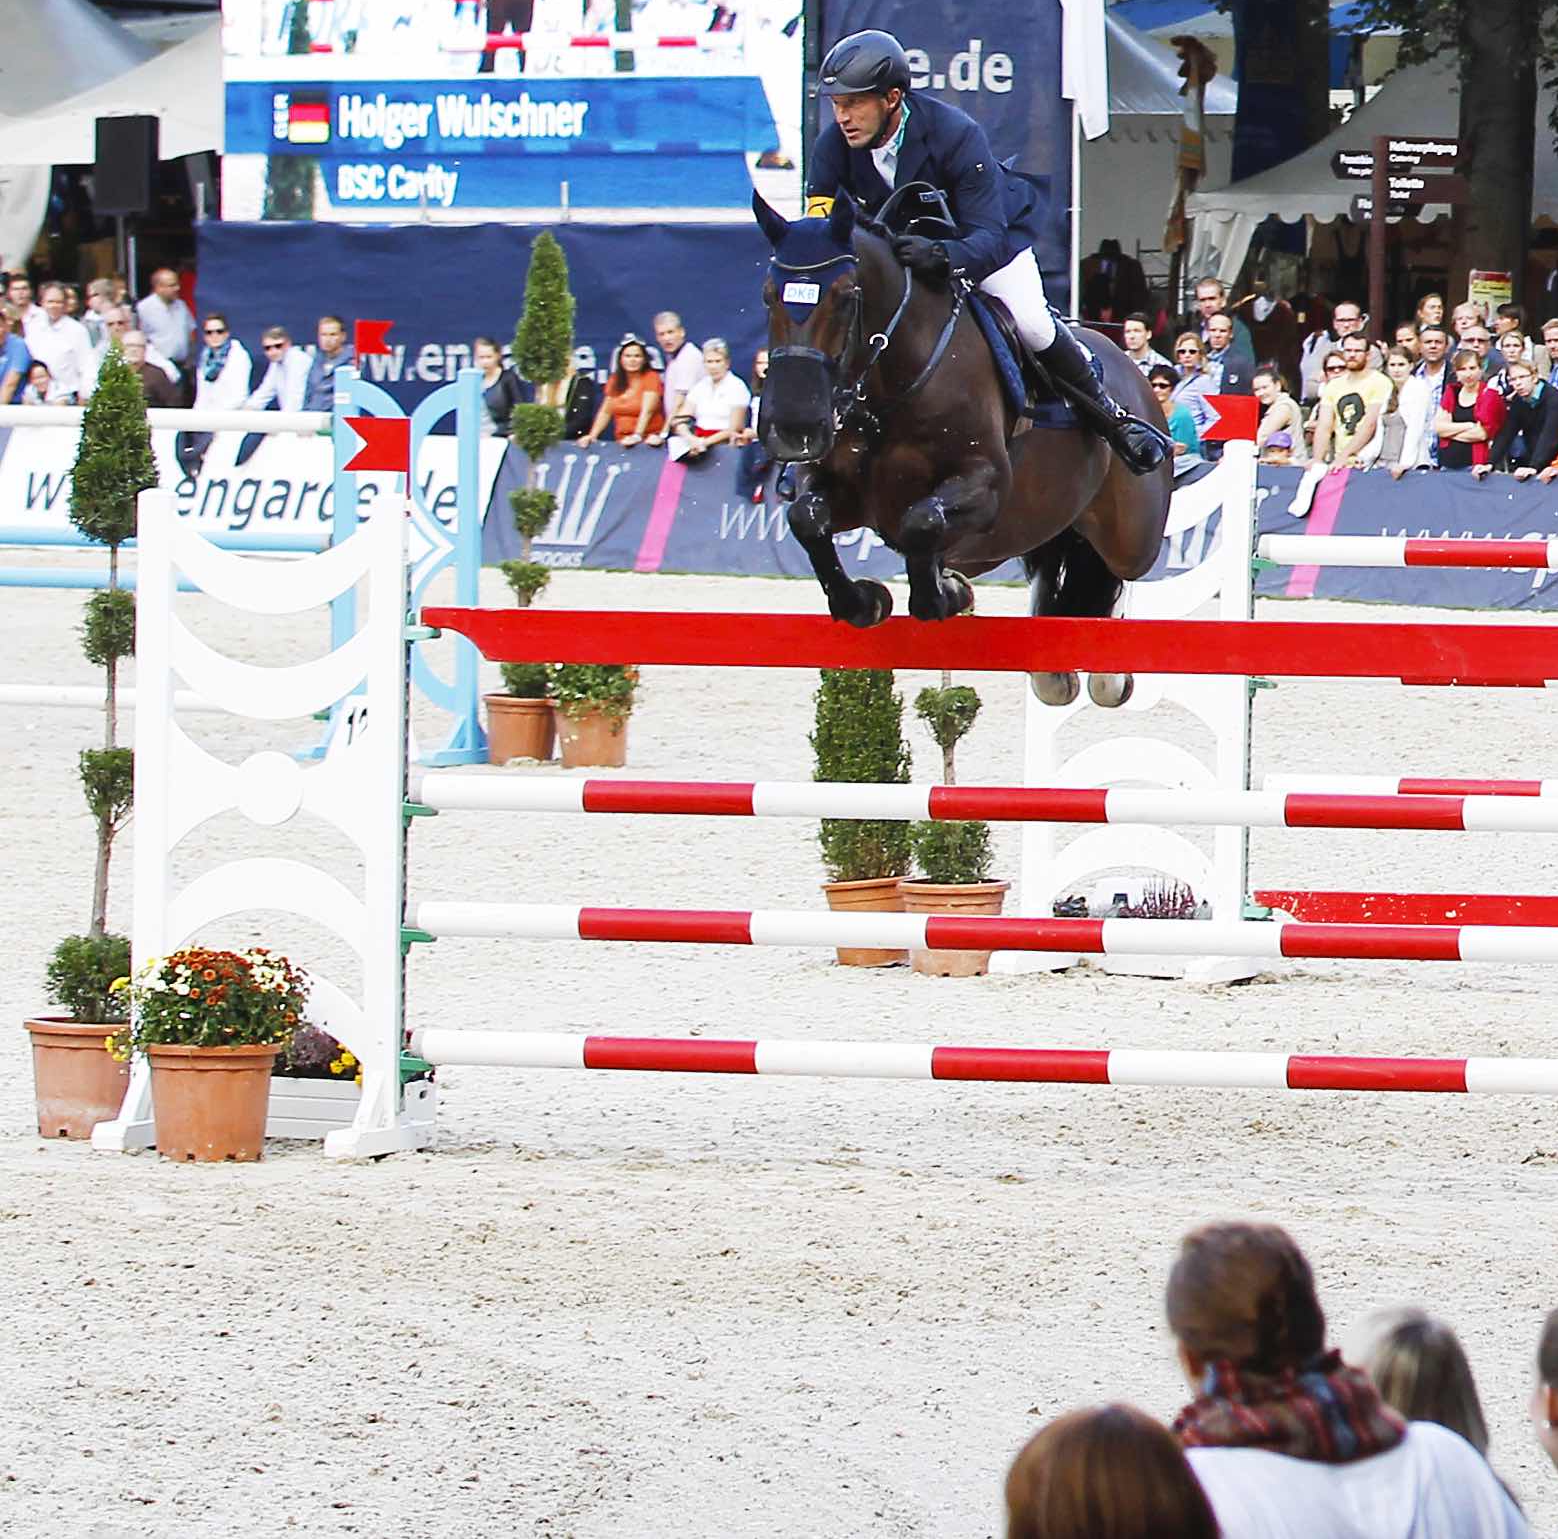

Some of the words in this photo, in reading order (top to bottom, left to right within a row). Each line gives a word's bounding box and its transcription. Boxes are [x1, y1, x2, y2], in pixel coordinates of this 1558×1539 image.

[337, 93, 433, 150] Holger
[436, 92, 589, 138] Wulschner
[336, 164, 385, 200] BSC
[386, 163, 458, 207] Cavity
[786, 287, 816, 300] DKB
